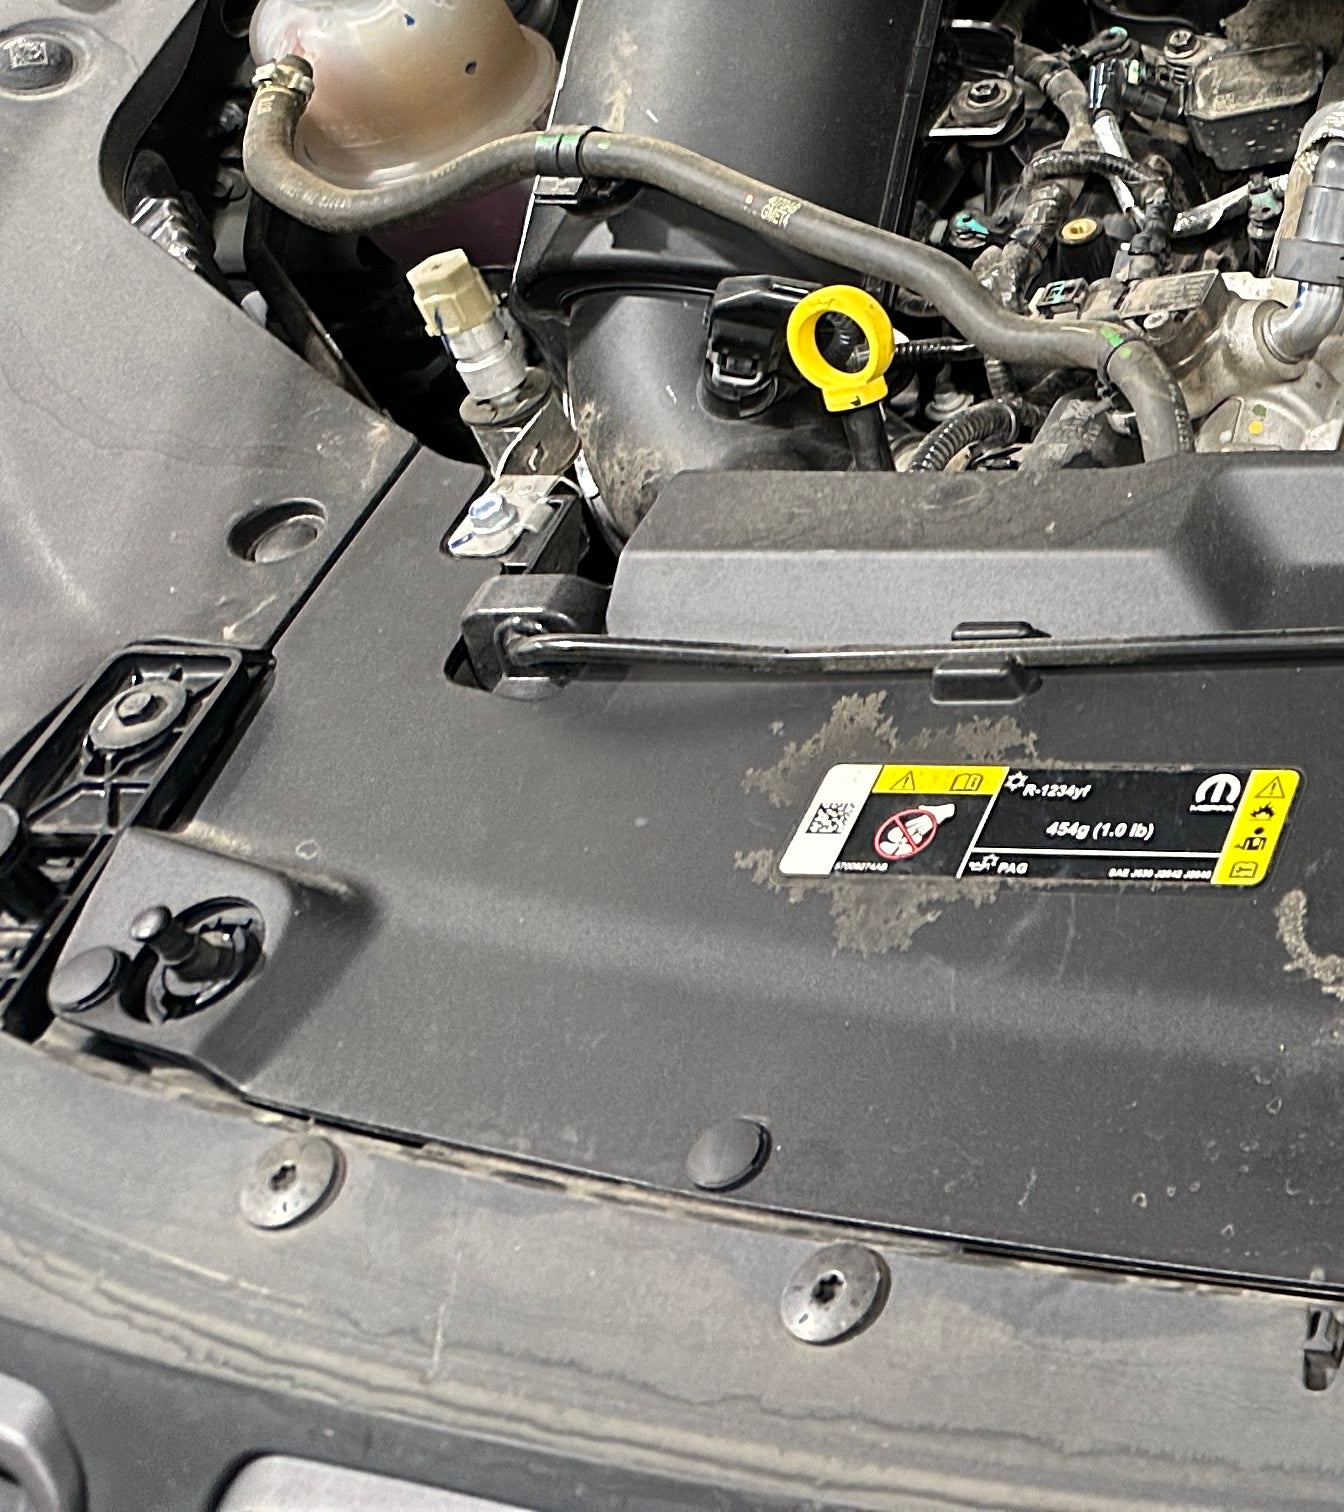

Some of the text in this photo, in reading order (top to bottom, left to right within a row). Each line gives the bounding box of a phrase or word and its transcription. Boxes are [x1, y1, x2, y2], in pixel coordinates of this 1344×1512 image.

[1022, 783, 1092, 800] R-1234yf
[1046, 821, 1155, 841] 454g (1.0 lb)
[997, 861, 1029, 875] PAG
